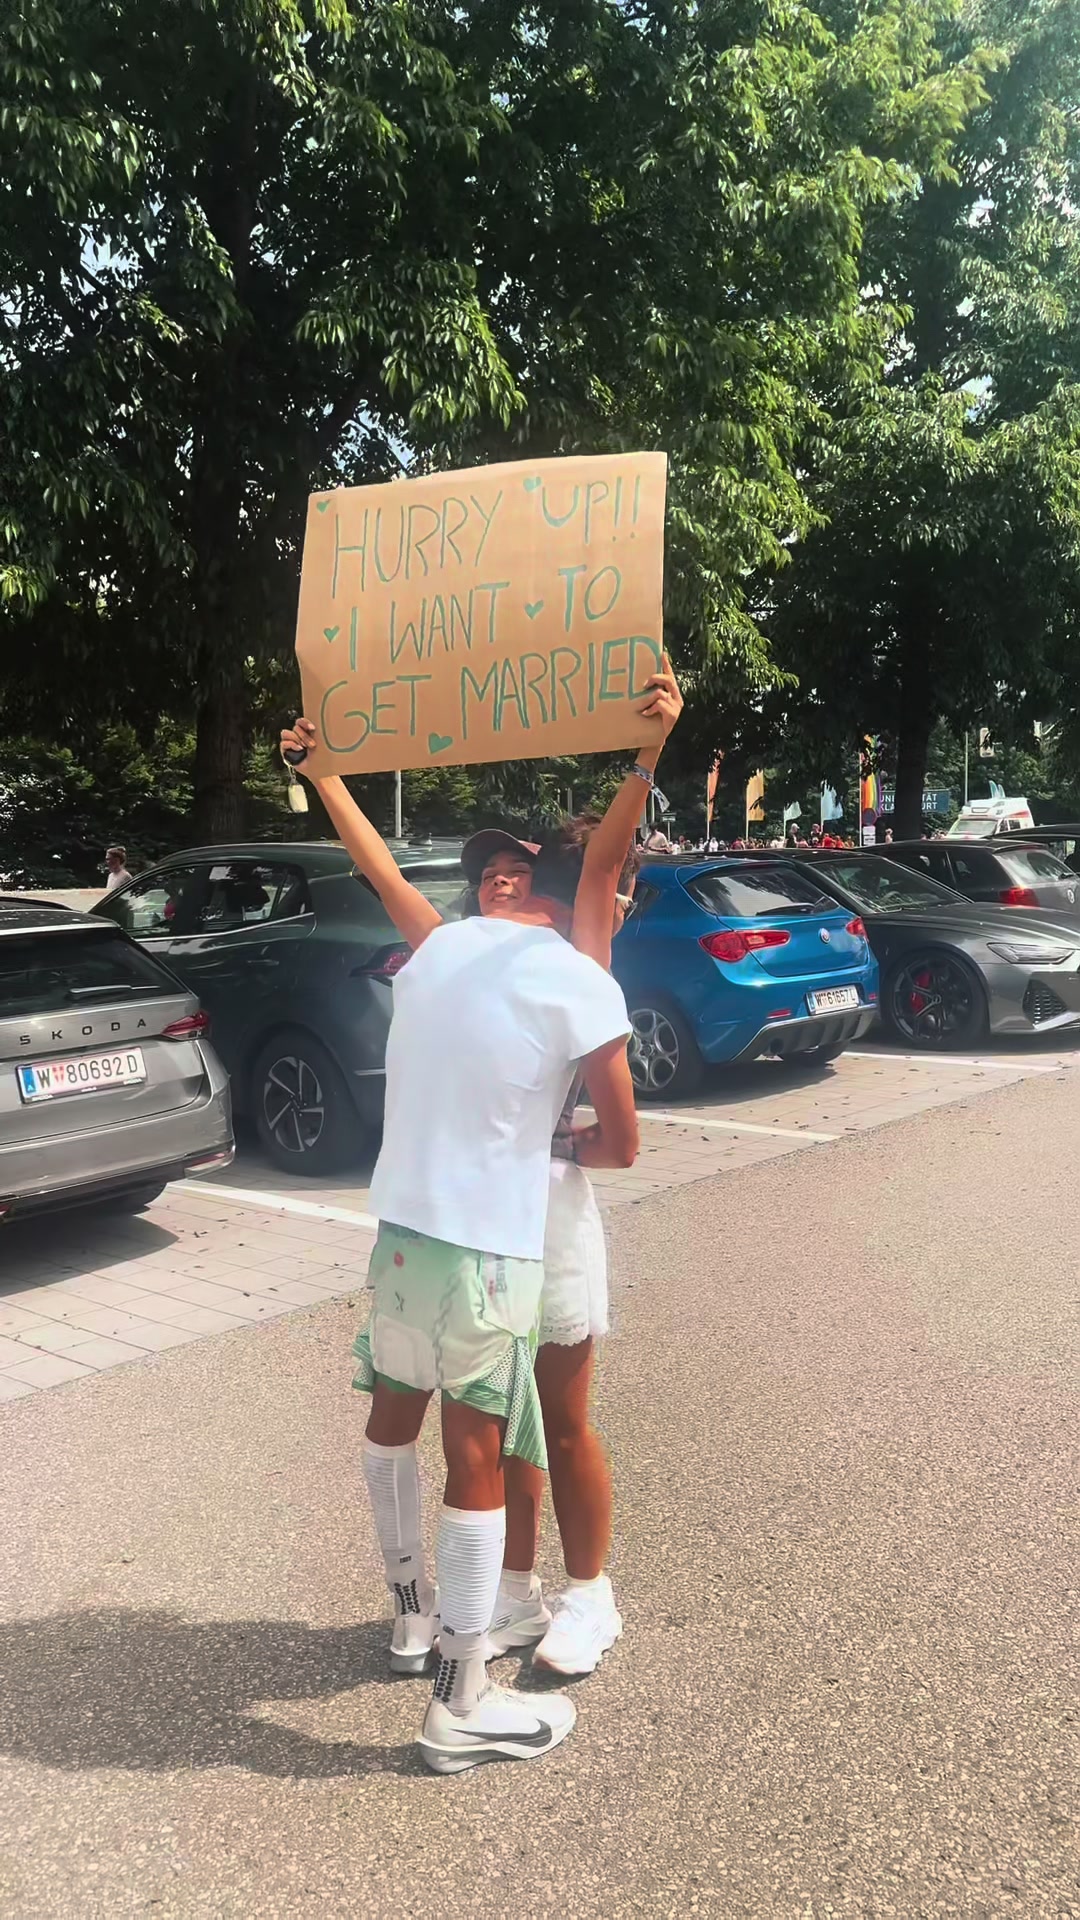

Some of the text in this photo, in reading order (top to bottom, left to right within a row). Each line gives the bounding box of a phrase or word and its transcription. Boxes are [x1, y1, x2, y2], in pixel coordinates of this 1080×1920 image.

[331, 475, 642, 599] HURRY UP!!
[349, 563, 622, 672] I WANT TO
[320, 634, 663, 753] GET MARRIED
[19, 1018, 147, 1045] SKODA
